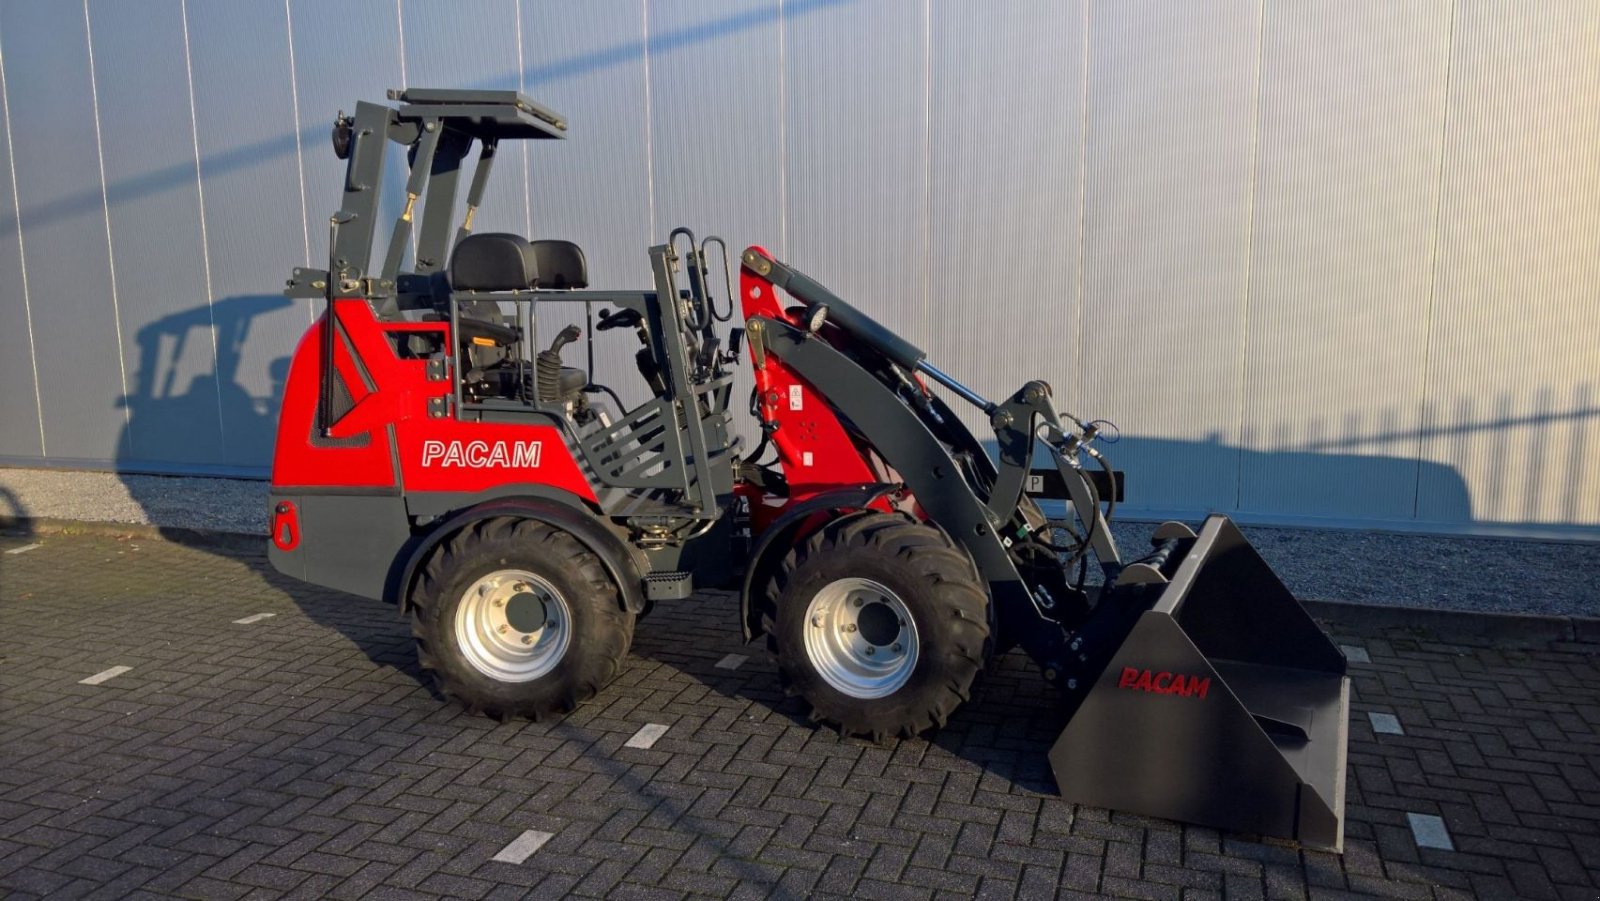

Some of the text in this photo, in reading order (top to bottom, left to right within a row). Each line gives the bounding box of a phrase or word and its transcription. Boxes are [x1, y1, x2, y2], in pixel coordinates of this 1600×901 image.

[421, 440, 542, 468] PACAM
[1031, 476, 1040, 491] P
[1118, 667, 1211, 699] PACAM
